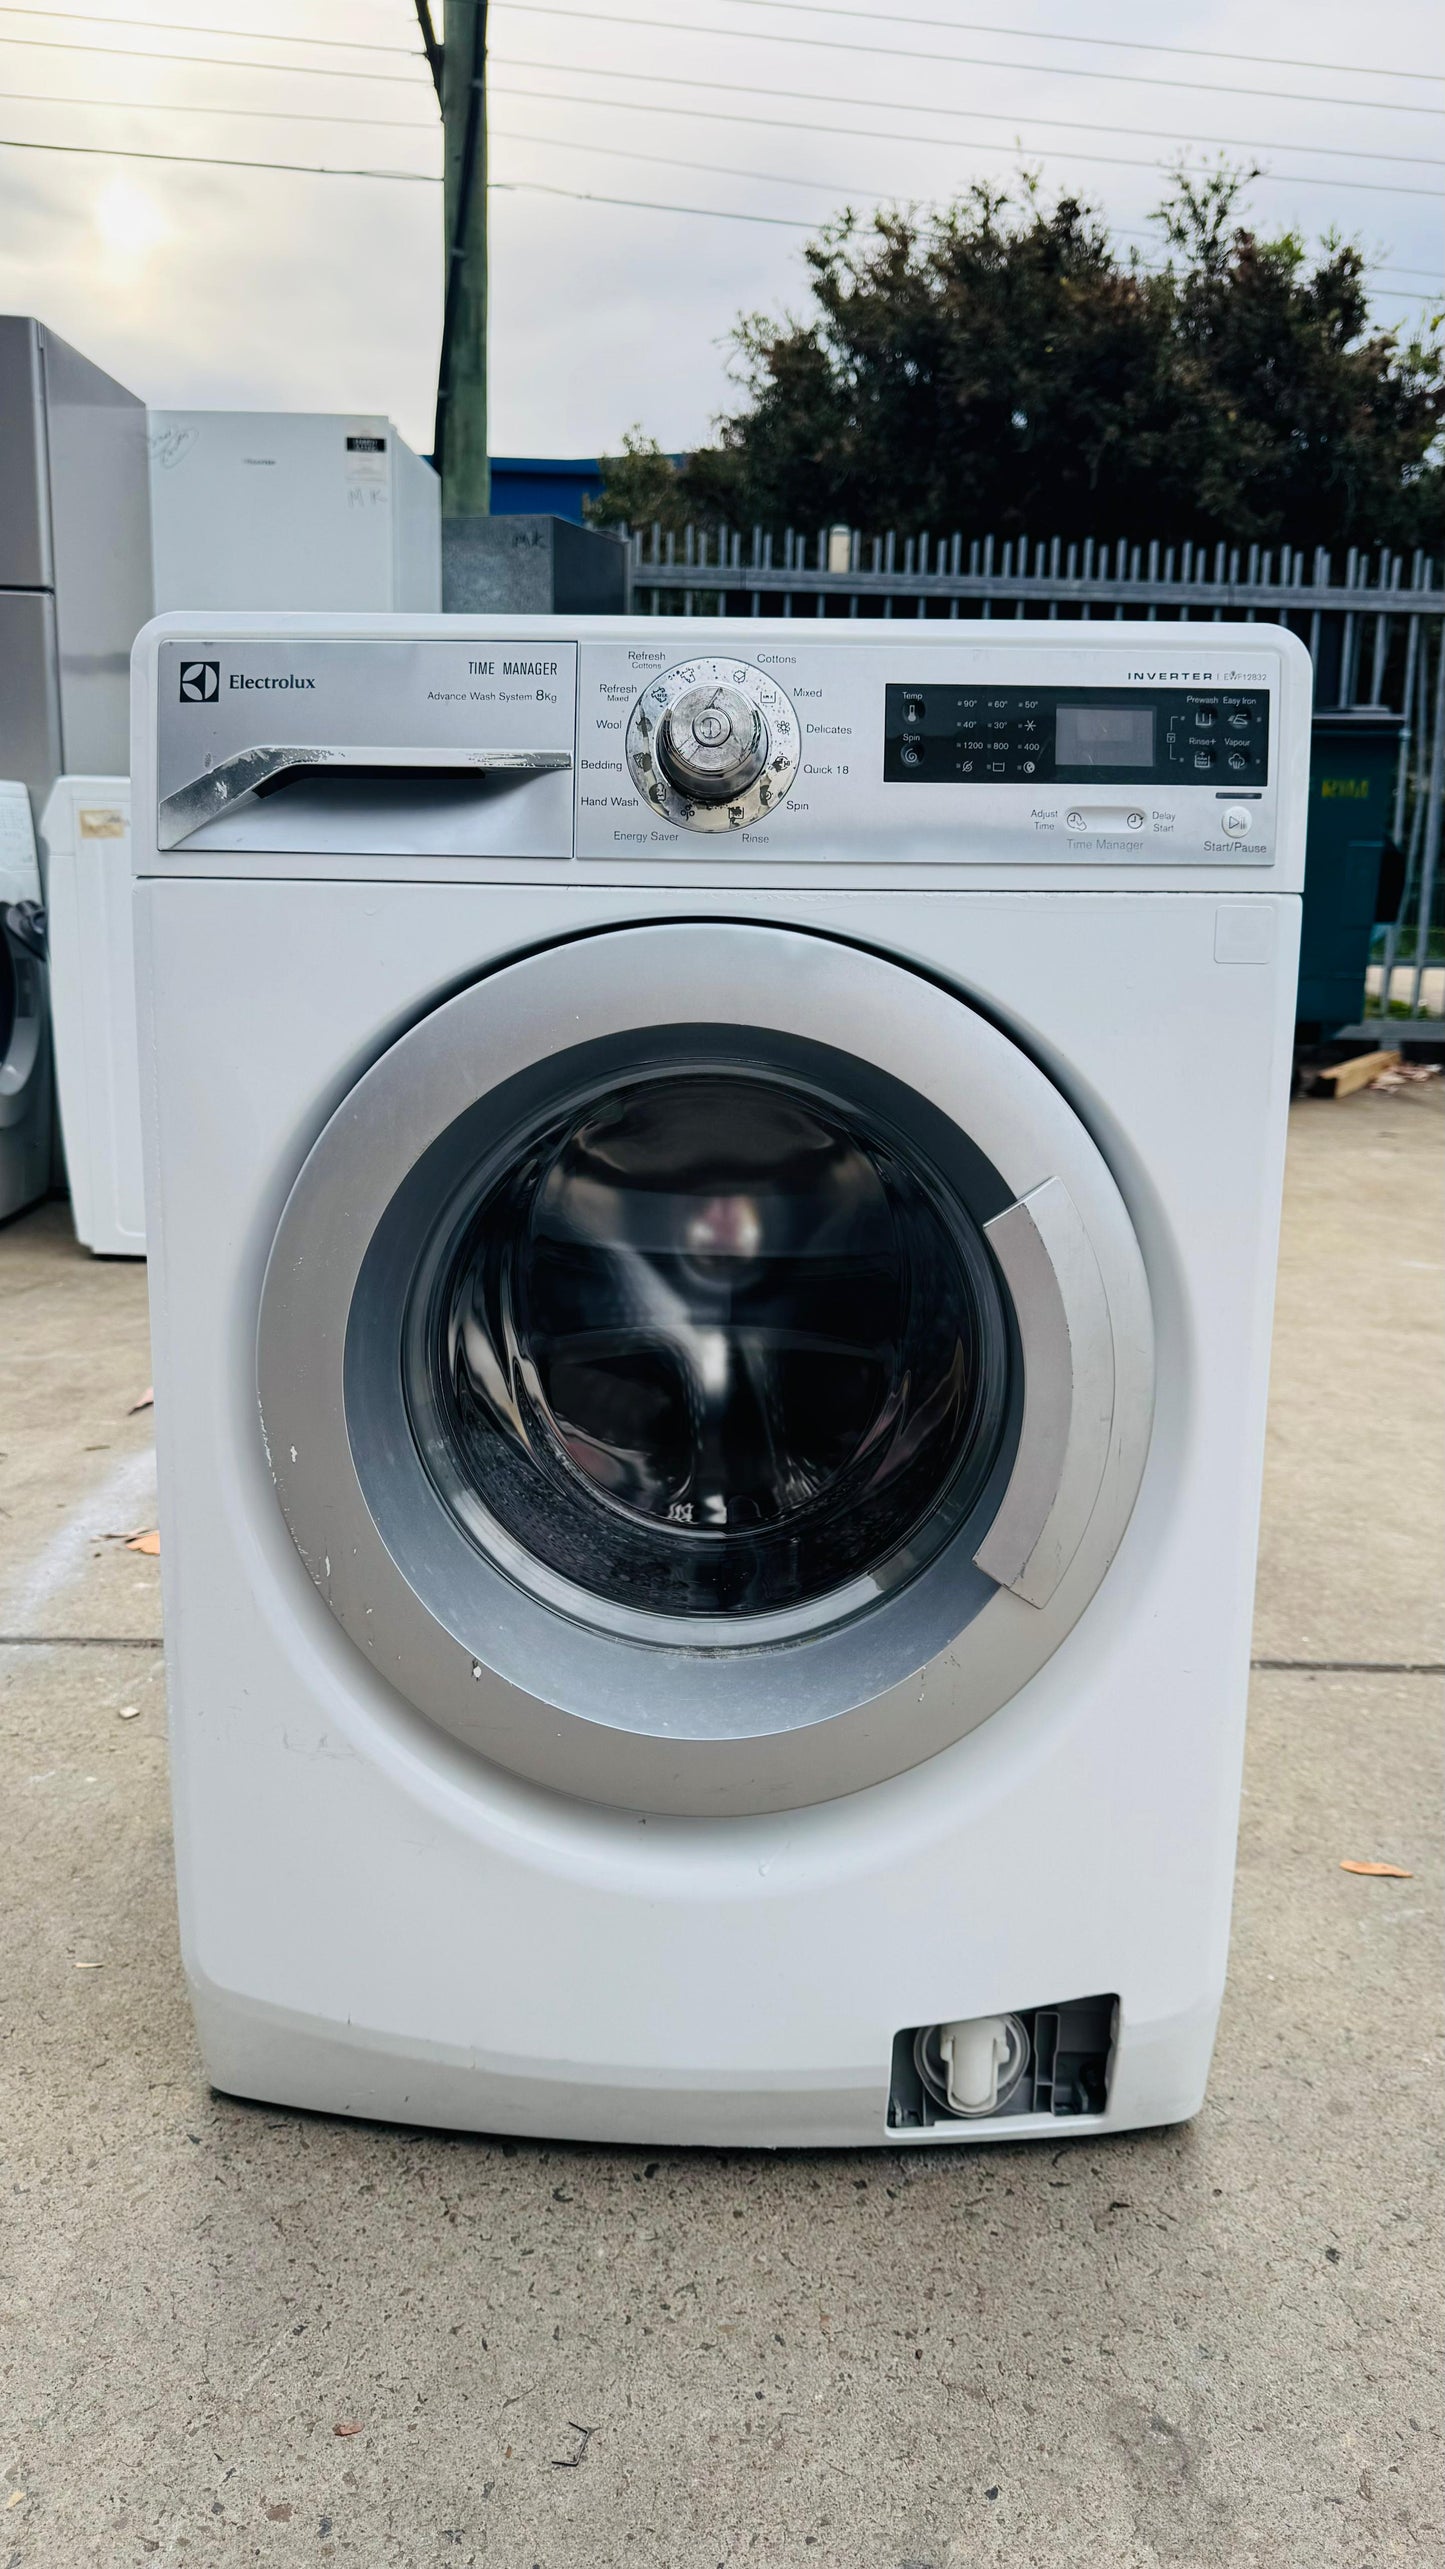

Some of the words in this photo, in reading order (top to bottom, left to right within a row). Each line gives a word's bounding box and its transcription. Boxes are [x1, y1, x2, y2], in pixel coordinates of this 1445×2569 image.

[628, 651, 666, 661] Refresh
[756, 654, 797, 664] Cottons
[468, 662, 495, 675] TIME
[502, 662, 558, 676] MANAGER
[631, 662, 662, 670] Cottons
[1128, 672, 1212, 680] INVERTER
[229, 674, 316, 690] Electrolux
[599, 684, 637, 693] Refresh
[793, 688, 823, 698] Mixed
[427, 691, 467, 701] Advance
[469, 692, 496, 701] Wash
[499, 692, 533, 704] System
[902, 692, 923, 700] Temp
[1186, 695, 1219, 704] Prewash
[1223, 696, 1240, 706] Easy
[1242, 696, 1257, 704] Iron
[963, 700, 977, 708] 90°
[596, 720, 622, 729] Wool
[806, 724, 852, 734] Delicates
[994, 721, 1007, 729] 30°
[902, 733, 920, 743] Spin
[1224, 738, 1251, 747] Vapour
[964, 742, 983, 750] 1200
[1024, 743, 1040, 751] 400
[581, 760, 622, 772] Bedding
[803, 765, 832, 775] Quick
[837, 765, 849, 775] 18
[580, 797, 607, 806] Hand
[610, 797, 639, 807] Wash
[786, 801, 809, 812] Spin
[1030, 809, 1058, 820] Adjust
[1152, 811, 1176, 822] Delay
[1034, 822, 1055, 830] Time
[1153, 823, 1174, 832] Start
[613, 831, 648, 843] Energy
[650, 832, 679, 842] Saver
[742, 834, 770, 844] Rinse
[1066, 839, 1091, 849] Time
[1096, 839, 1144, 852] Manager
[1203, 841, 1267, 854] Start/Pause
